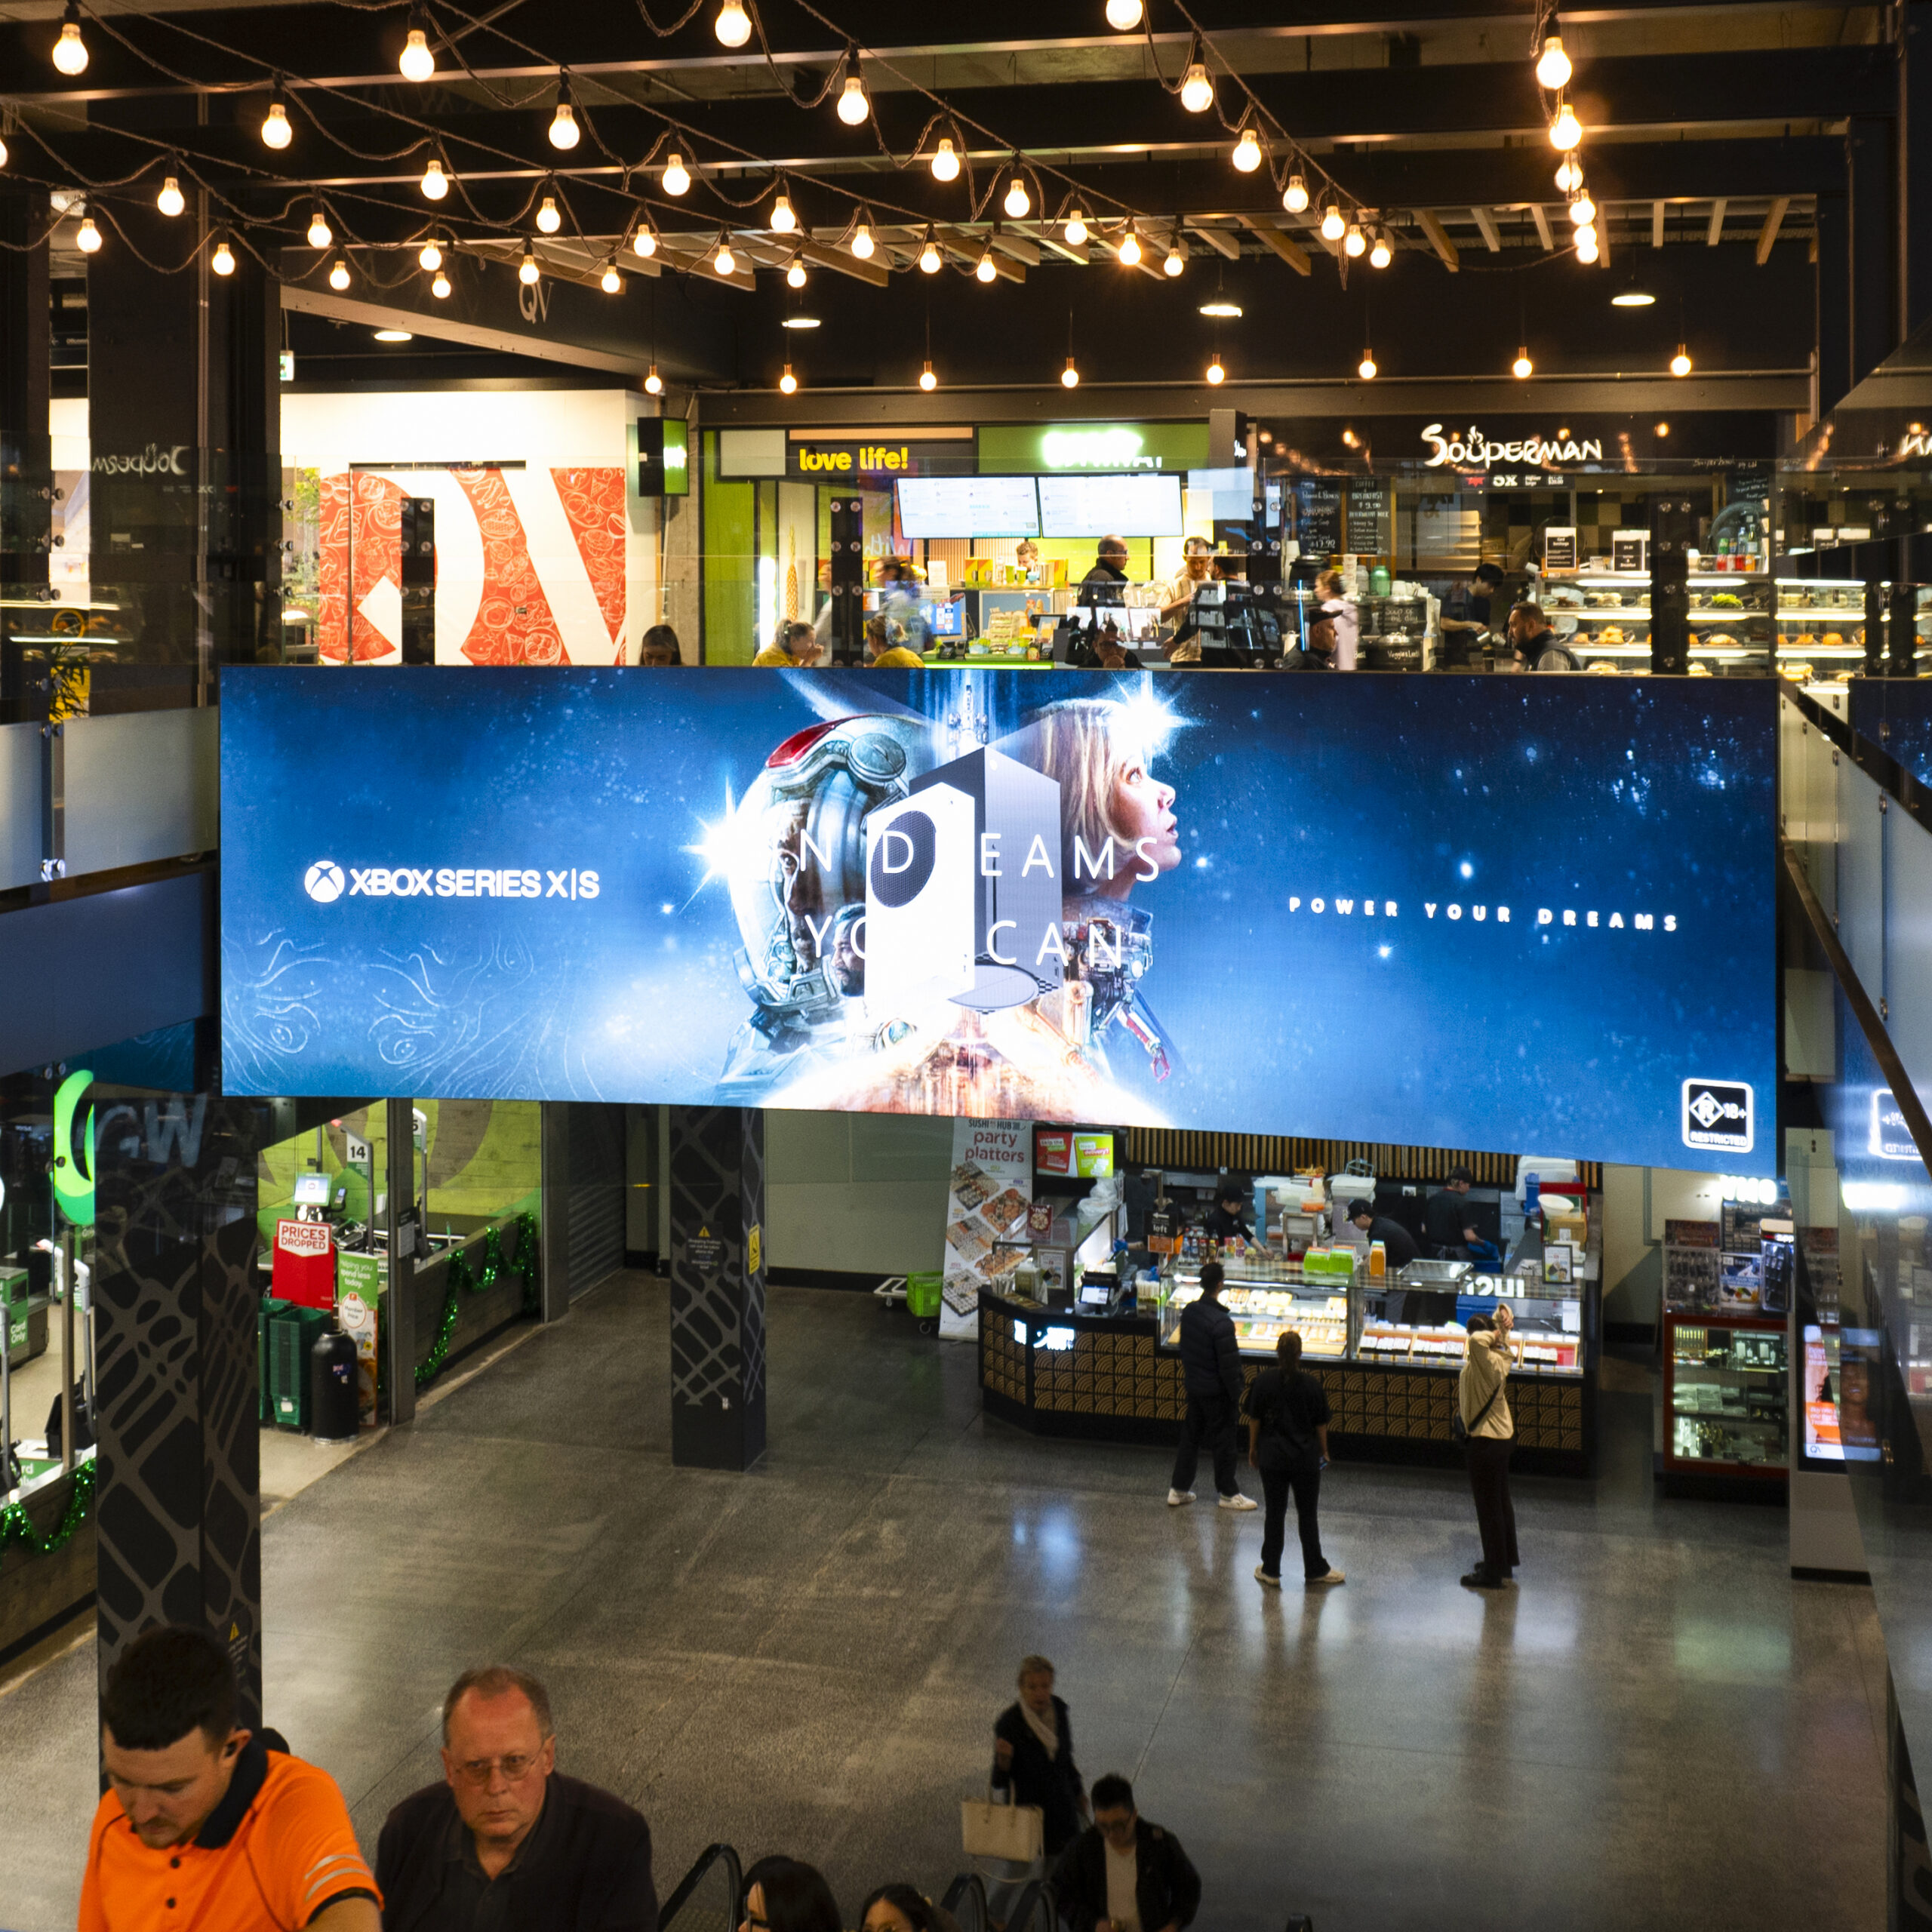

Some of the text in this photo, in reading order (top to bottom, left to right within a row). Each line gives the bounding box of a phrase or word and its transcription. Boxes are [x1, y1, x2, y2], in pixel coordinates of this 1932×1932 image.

[799, 446, 908, 471] love life!
[349, 868, 433, 897] XBOX
[435, 869, 542, 898] SERIES
[1289, 897, 1678, 932] POWER YOUR DREAMS
[986, 920, 1122, 969] CAN
[1722, 1102, 1747, 1119] 18+
[968, 1118, 1012, 1131] SUSHI HUB
[974, 1131, 1017, 1148] party
[1690, 1131, 1747, 1146] RESTRICTED
[350, 1146, 366, 1159] 14
[964, 1146, 1025, 1163] platters
[281, 1225, 326, 1241] PRICES
[281, 1237, 326, 1251] DROPPED
[11, 1321, 26, 1335] Card
[11, 1331, 26, 1344] Only
